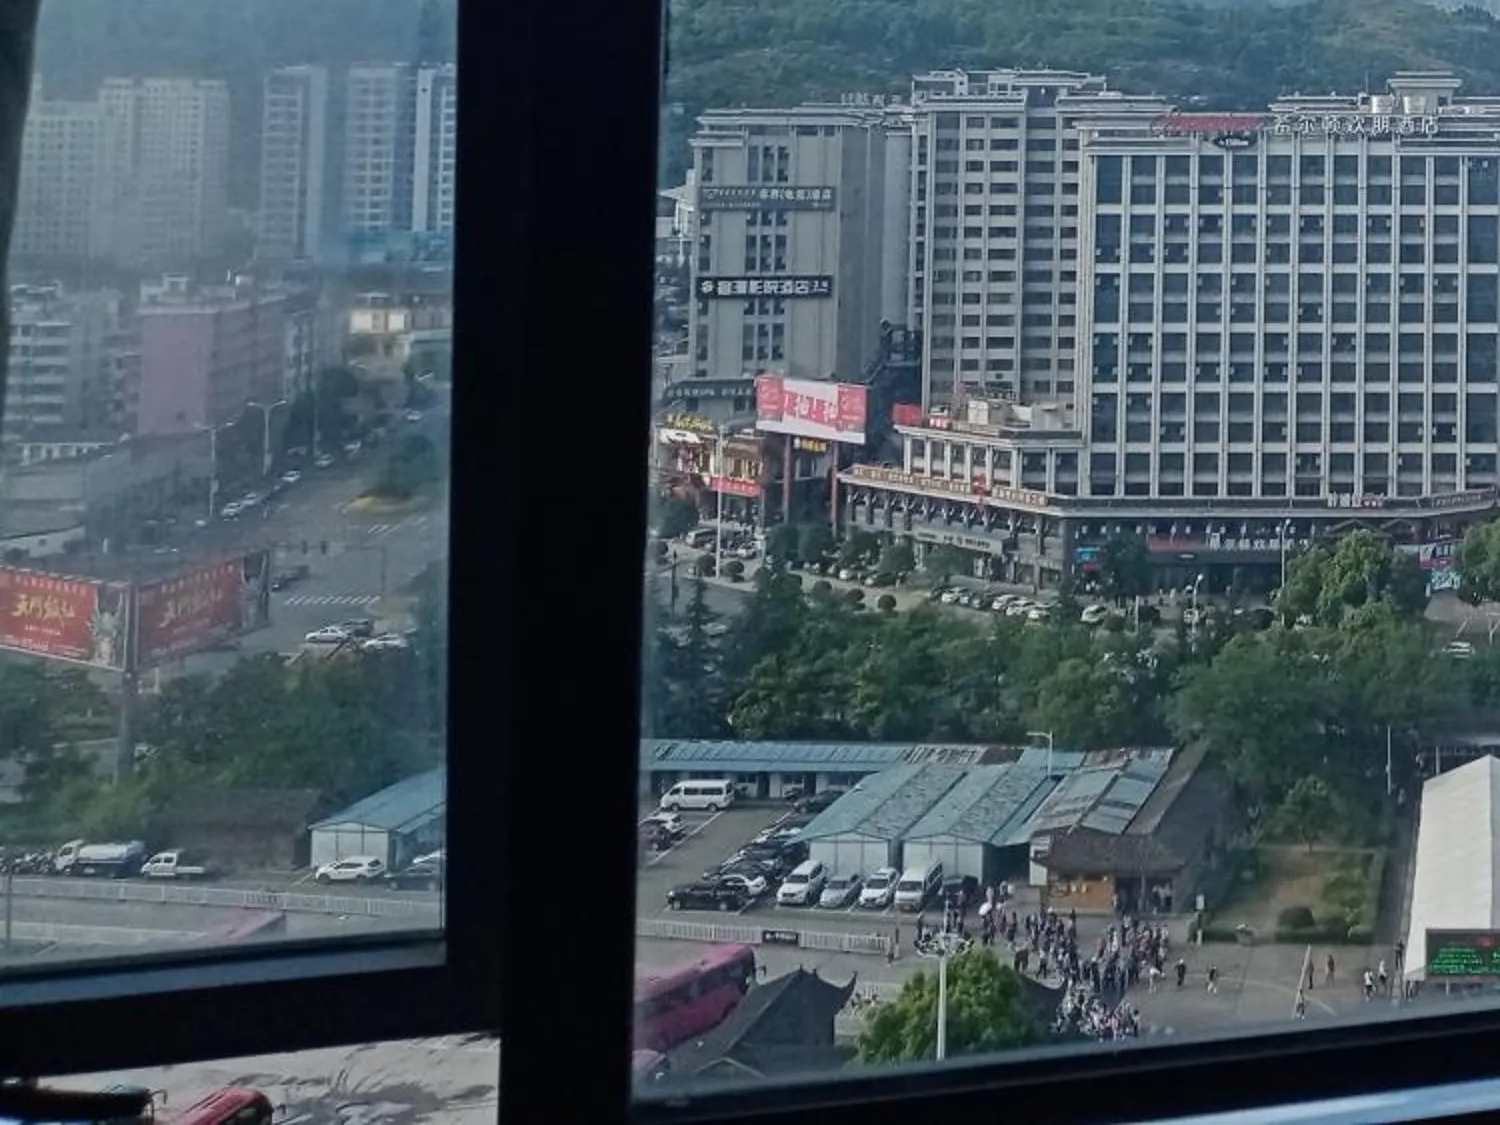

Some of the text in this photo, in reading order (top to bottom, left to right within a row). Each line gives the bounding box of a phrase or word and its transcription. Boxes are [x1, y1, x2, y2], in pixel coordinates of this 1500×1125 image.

[1273, 114, 1440, 135] 希尔顿欢朋酒店
